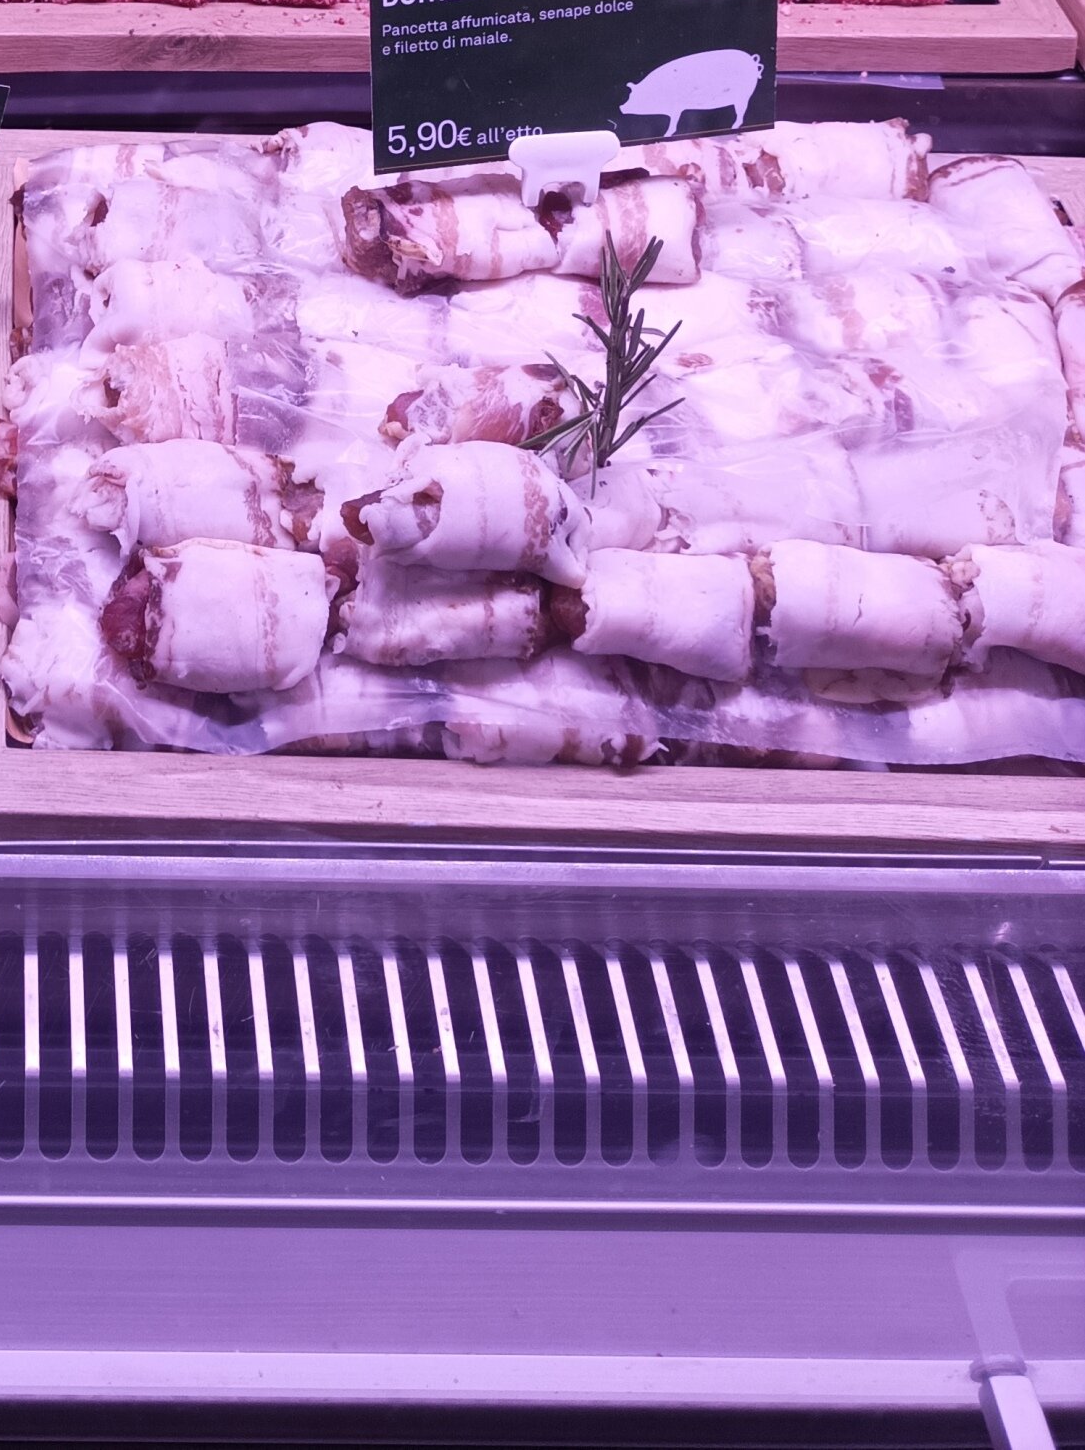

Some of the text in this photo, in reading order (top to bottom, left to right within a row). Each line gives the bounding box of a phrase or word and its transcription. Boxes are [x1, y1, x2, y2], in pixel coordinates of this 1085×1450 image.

[382, 0, 634, 37] Pancetta affumicata, senape dolce
[382, 31, 512, 55] e filetto di maiale.
[388, 119, 472, 157] 5,90€
